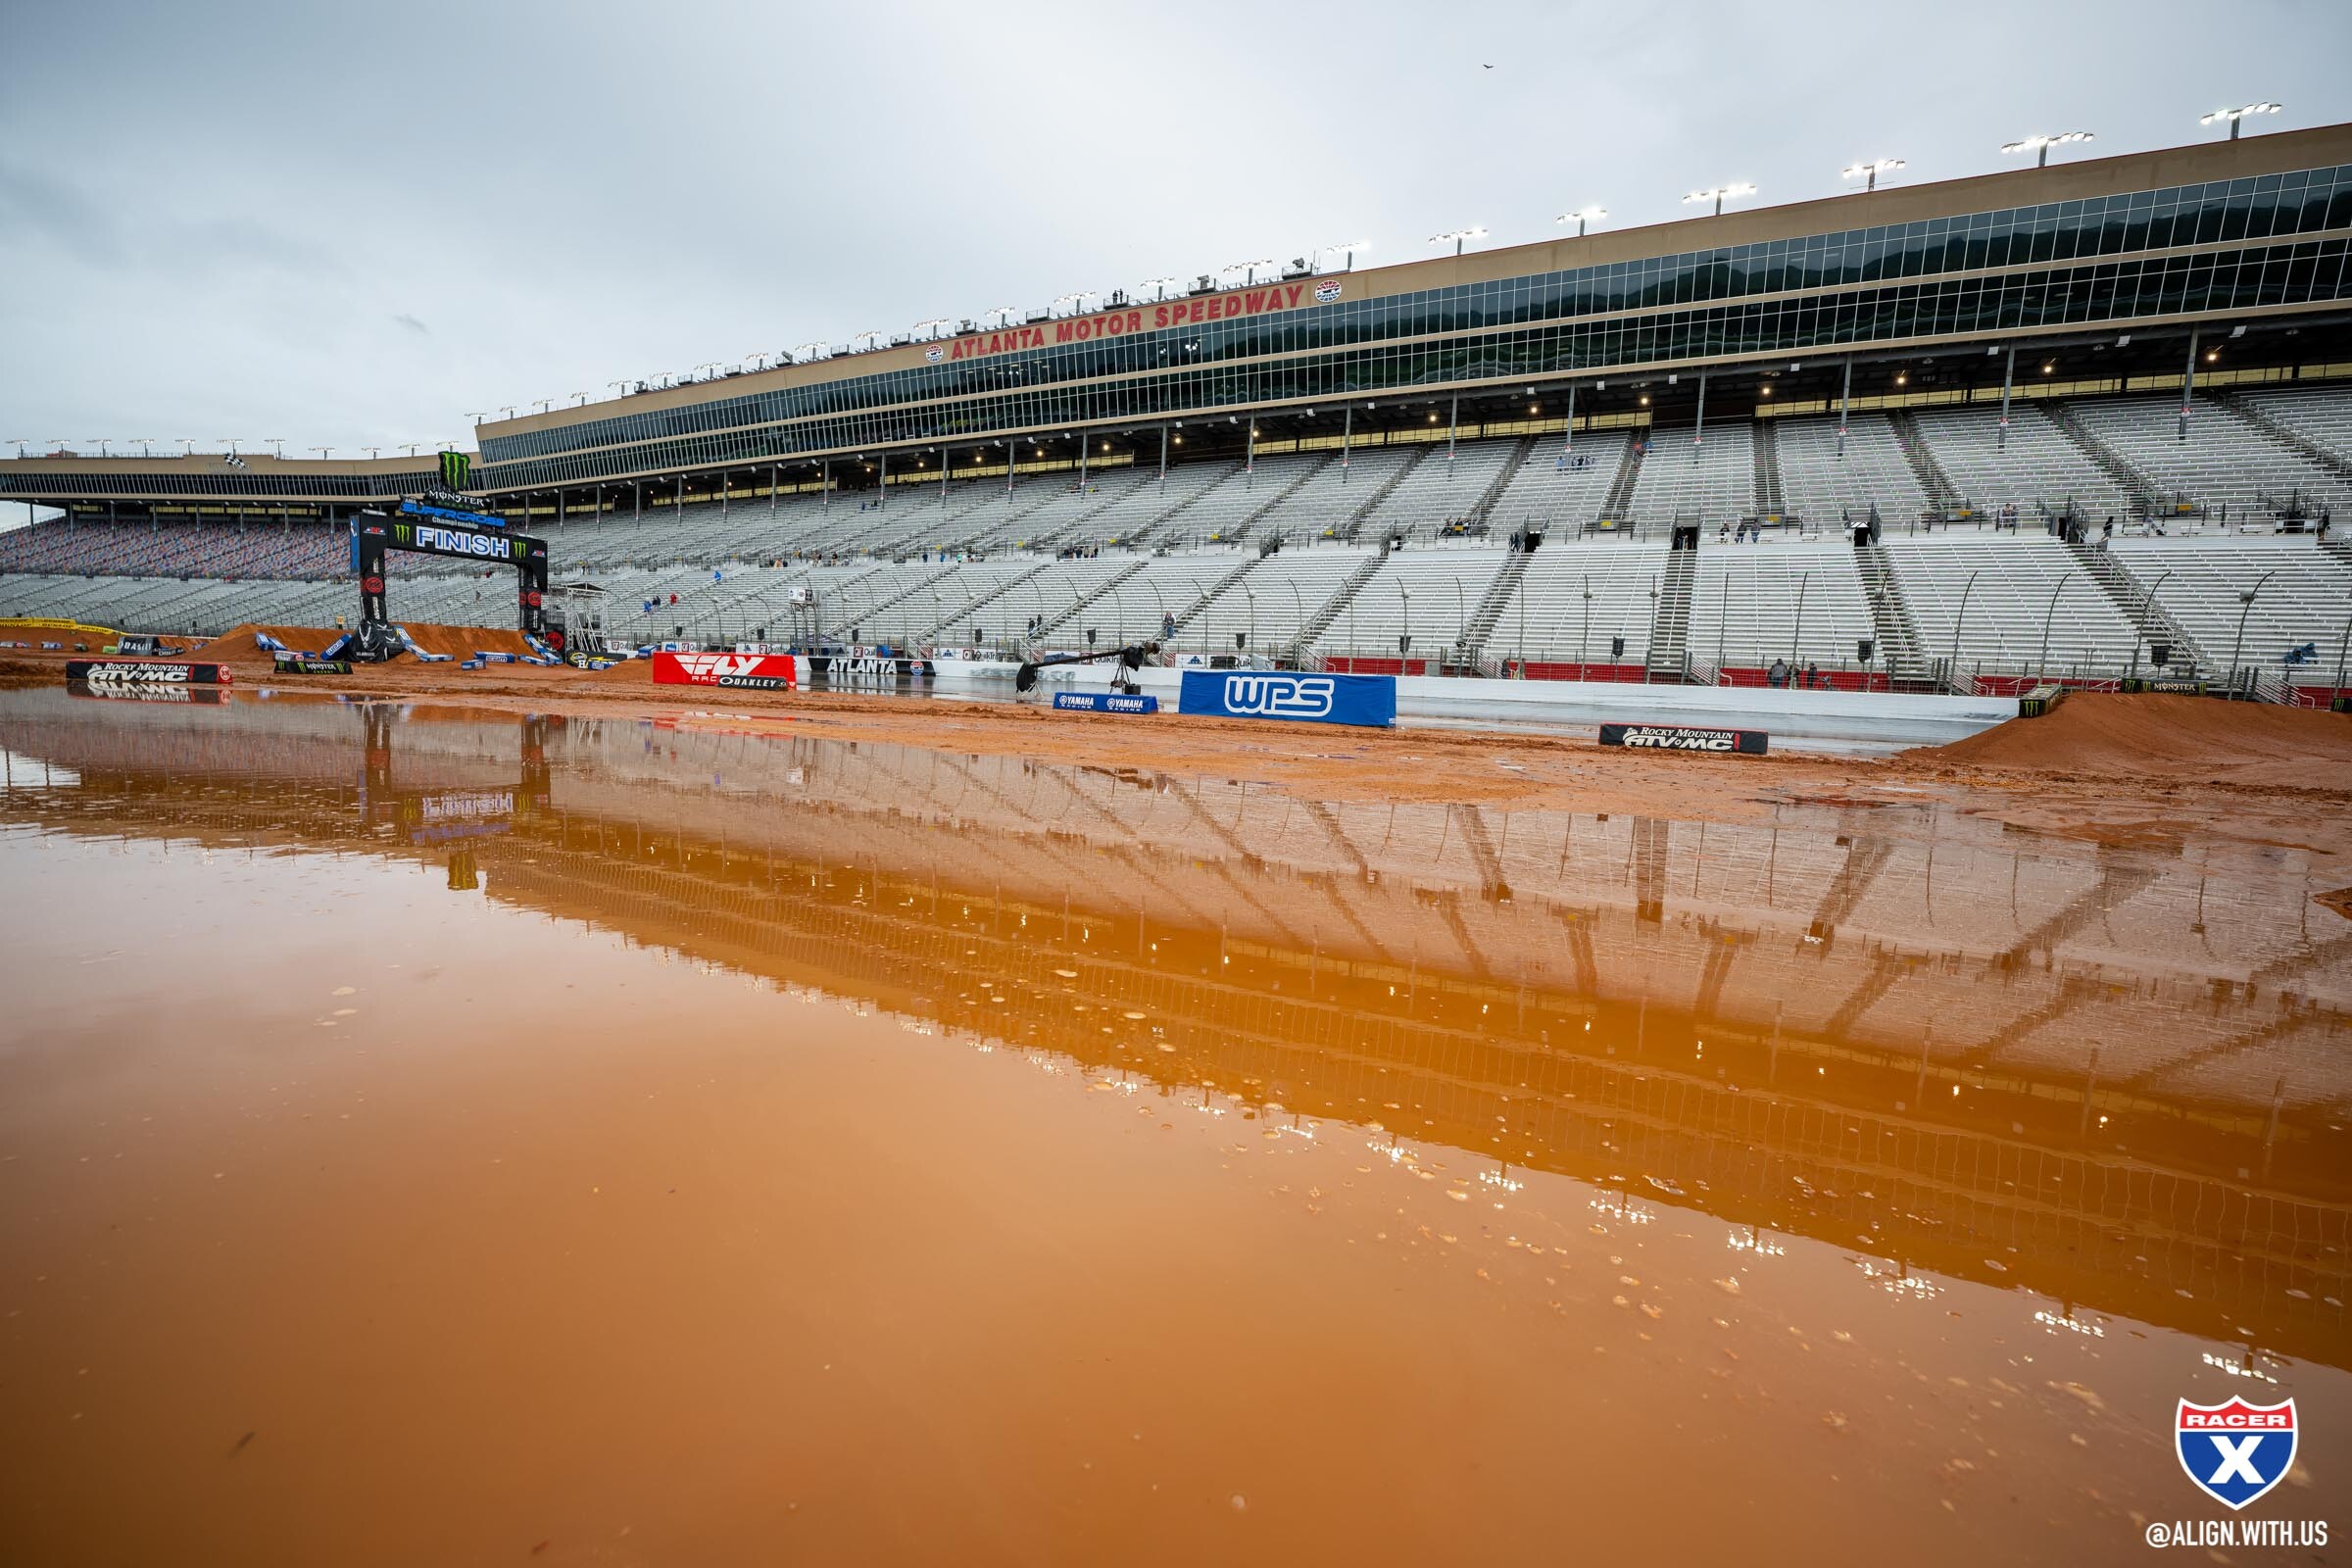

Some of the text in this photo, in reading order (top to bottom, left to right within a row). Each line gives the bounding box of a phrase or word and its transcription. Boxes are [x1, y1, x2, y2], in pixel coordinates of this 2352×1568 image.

[952, 284, 1304, 360] ATLANTA MOTOR SPEEDWAY
[401, 502, 506, 528] SUPERCROSS
[416, 525, 510, 559] FINISH
[138, 663, 190, 672] MOUNTAIN
[826, 659, 898, 674] ATLANTA
[2154, 682, 2195, 692] MONSTER
[1067, 696, 1095, 707] YAMAHA
[1114, 698, 1144, 709] YAMAHA
[1225, 676, 1335, 717] WPS
[1641, 727, 1734, 740] ROCKY MOUNTAIN
